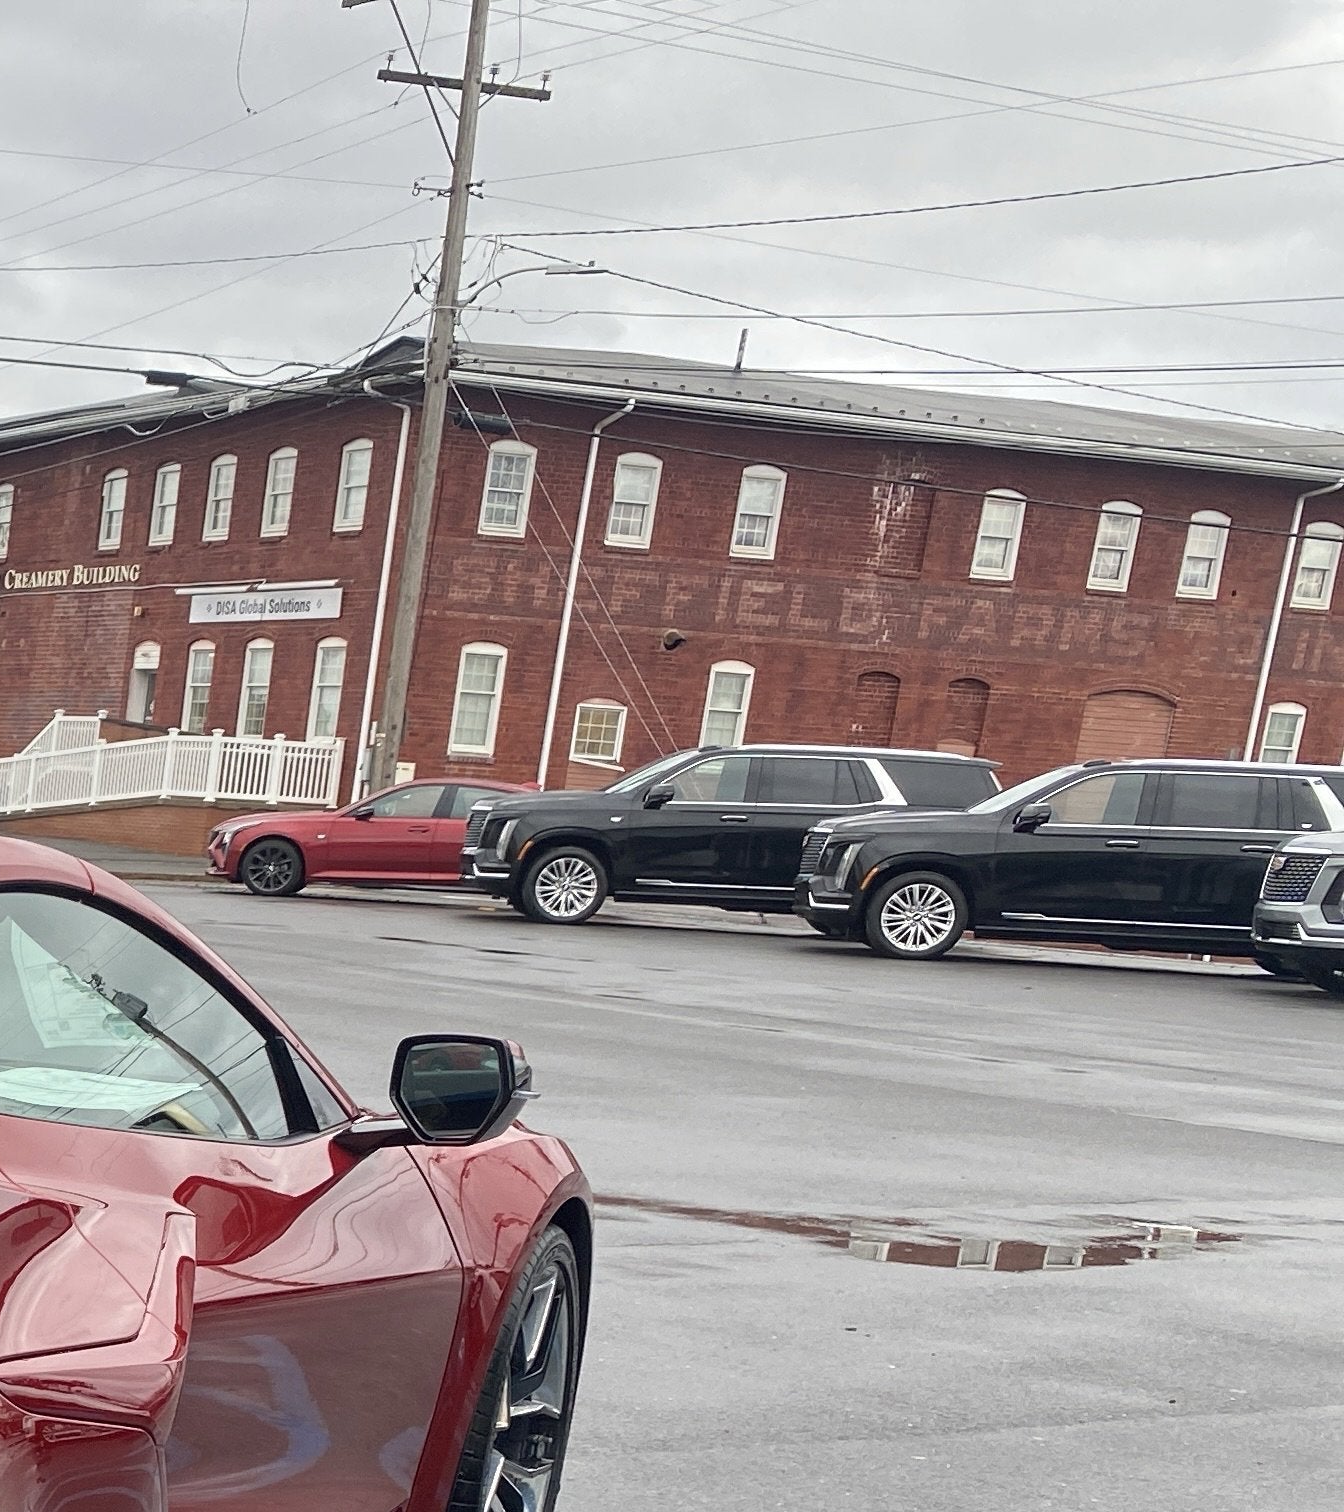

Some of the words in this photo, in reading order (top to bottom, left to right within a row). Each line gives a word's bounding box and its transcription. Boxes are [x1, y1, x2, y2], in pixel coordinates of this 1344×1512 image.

[4, 569, 71, 589] CREAMERY
[72, 564, 141, 585] BUILDING
[215, 600, 236, 615] DISA
[238, 599, 266, 614] Global
[269, 598, 311, 613] Solutions
